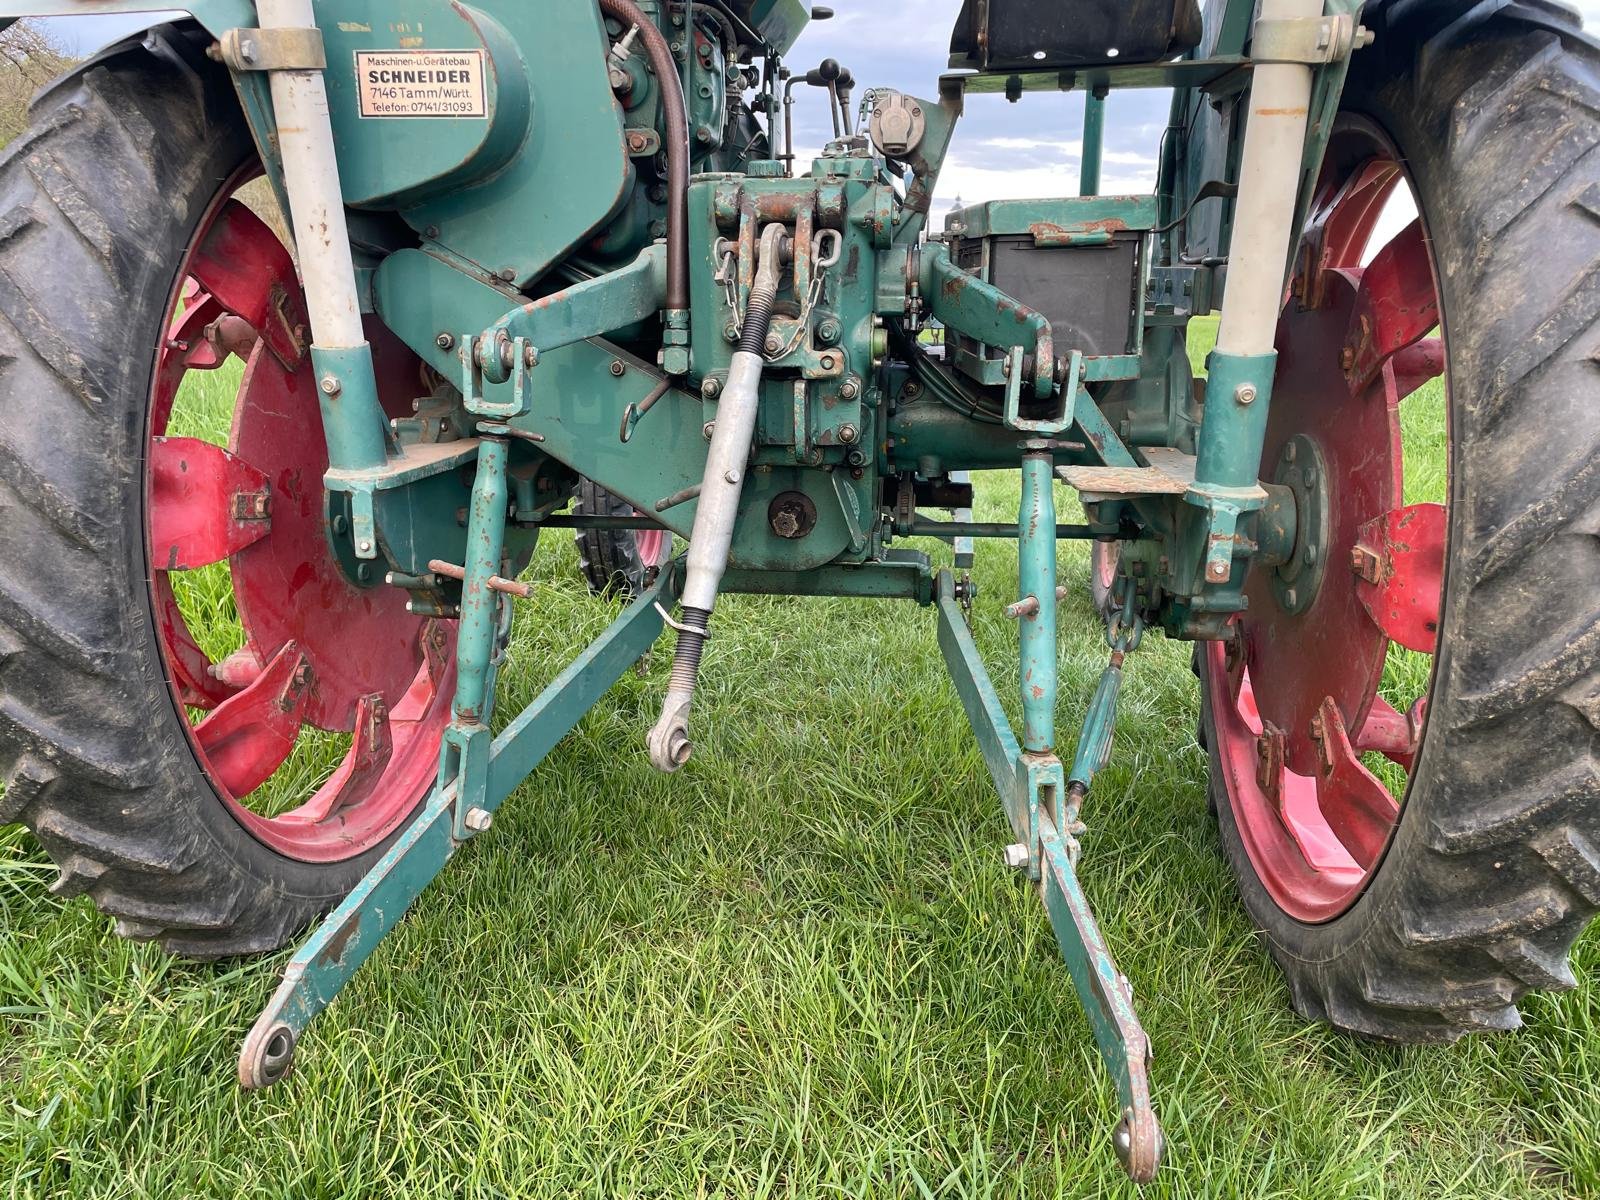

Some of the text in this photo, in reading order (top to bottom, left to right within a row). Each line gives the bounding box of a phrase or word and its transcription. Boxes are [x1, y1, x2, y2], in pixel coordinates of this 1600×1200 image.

[369, 70, 470, 83] SCHNEIDER
[371, 87, 472, 98] 7146 Tamm/Württ.
[372, 102, 472, 112] Telefon: 07141/31093
